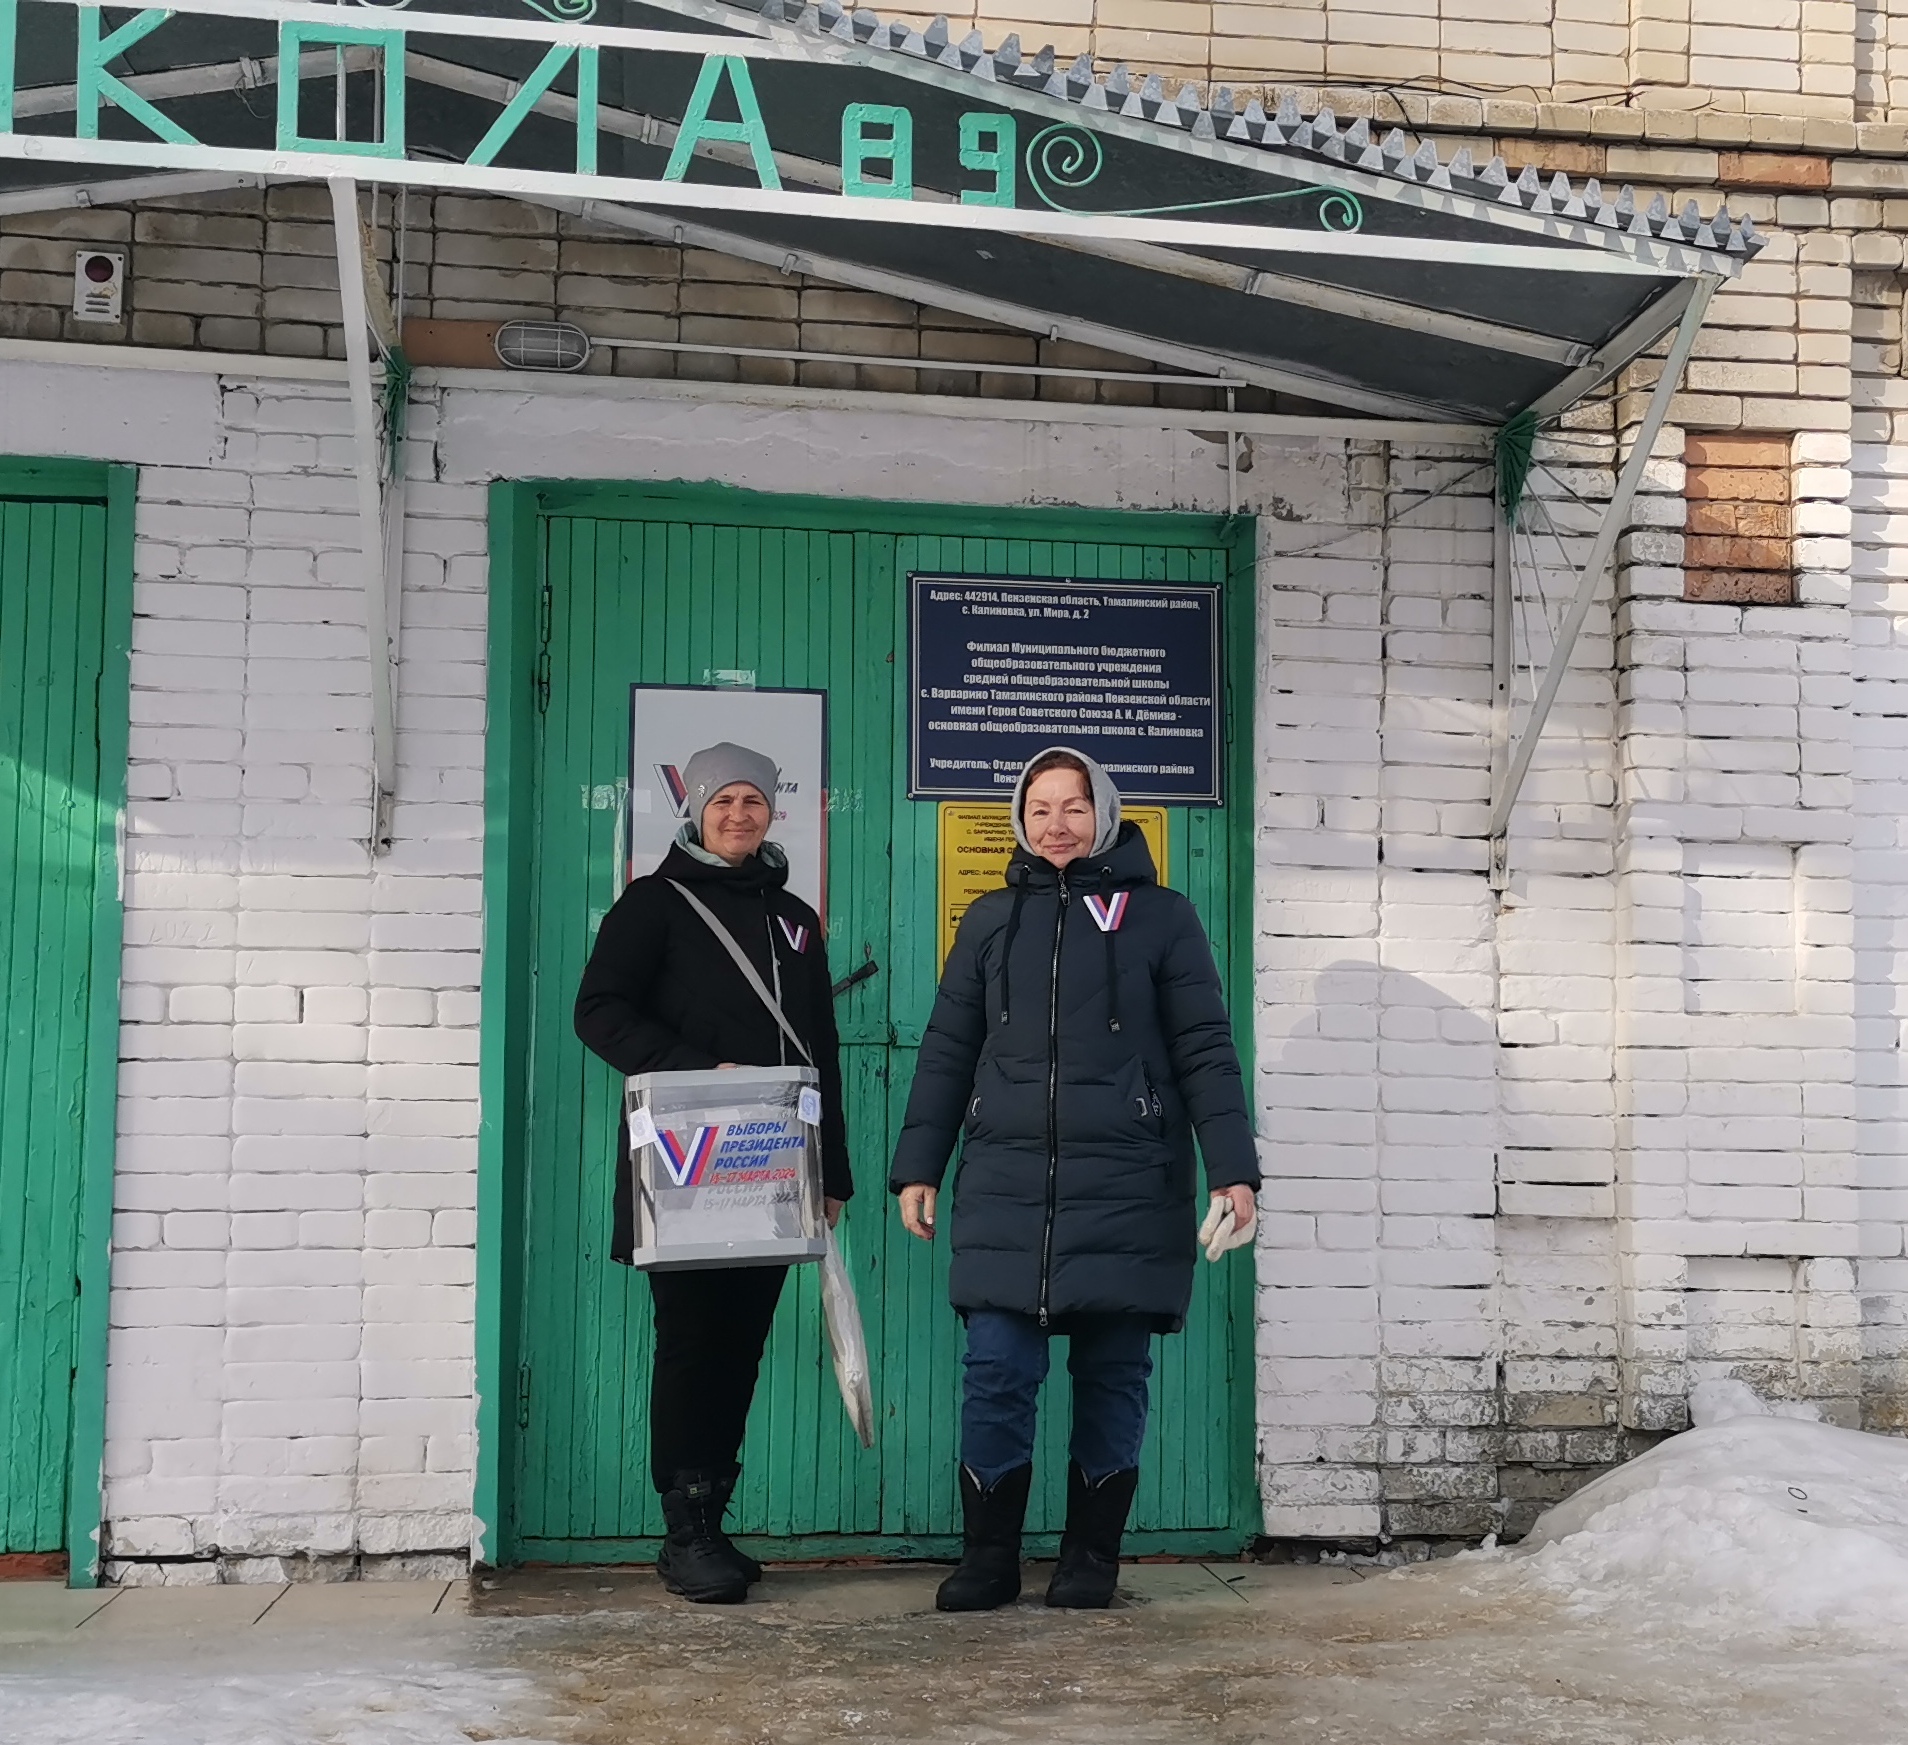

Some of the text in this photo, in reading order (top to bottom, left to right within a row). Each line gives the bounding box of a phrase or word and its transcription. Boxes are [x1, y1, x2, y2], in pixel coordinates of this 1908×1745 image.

[0, 0, 783, 192] КОЛА
[930, 589, 1200, 611] Адрес: 442914, Пензенская область, Тамалинский район,
[962, 605, 1090, 620] с. Калиновка, ул. Мира, д. 2
[966, 640, 1166, 658] Филиал Муниципального бюджетного
[971, 657, 1162, 674] общеобразовательного учреждения
[964, 673, 1170, 689] средней общеобразовательной школы
[921, 688, 1211, 706] с. Варварино Тамалинского района Пензенской области
[950, 705, 985, 716] имени
[987, 705, 1017, 717] Героя
[1019, 705, 1077, 718] Советского
[1079, 707, 1113, 719] Союза
[1114, 709, 1123, 720] А.
[1125, 709, 1134, 720] И.
[1136, 709, 1176, 722] Дёмина
[928, 721, 1204, 738] основная общеобразовательная школа с. Калиновка
[930, 757, 991, 770] Учредитель:
[993, 759, 1023, 771] Отдел
[1100, 763, 1158, 774] малинского
[1160, 763, 1195, 775] района
[957, 845, 1005, 854] ОСНОВНАЯ
[726, 1121, 788, 1137] ВЫБОРЫ
[720, 1136, 806, 1153] ПРЕЗИДЕНТА
[713, 1154, 771, 1171] РОССИИ
[737, 1169, 771, 1182] МАРТА
